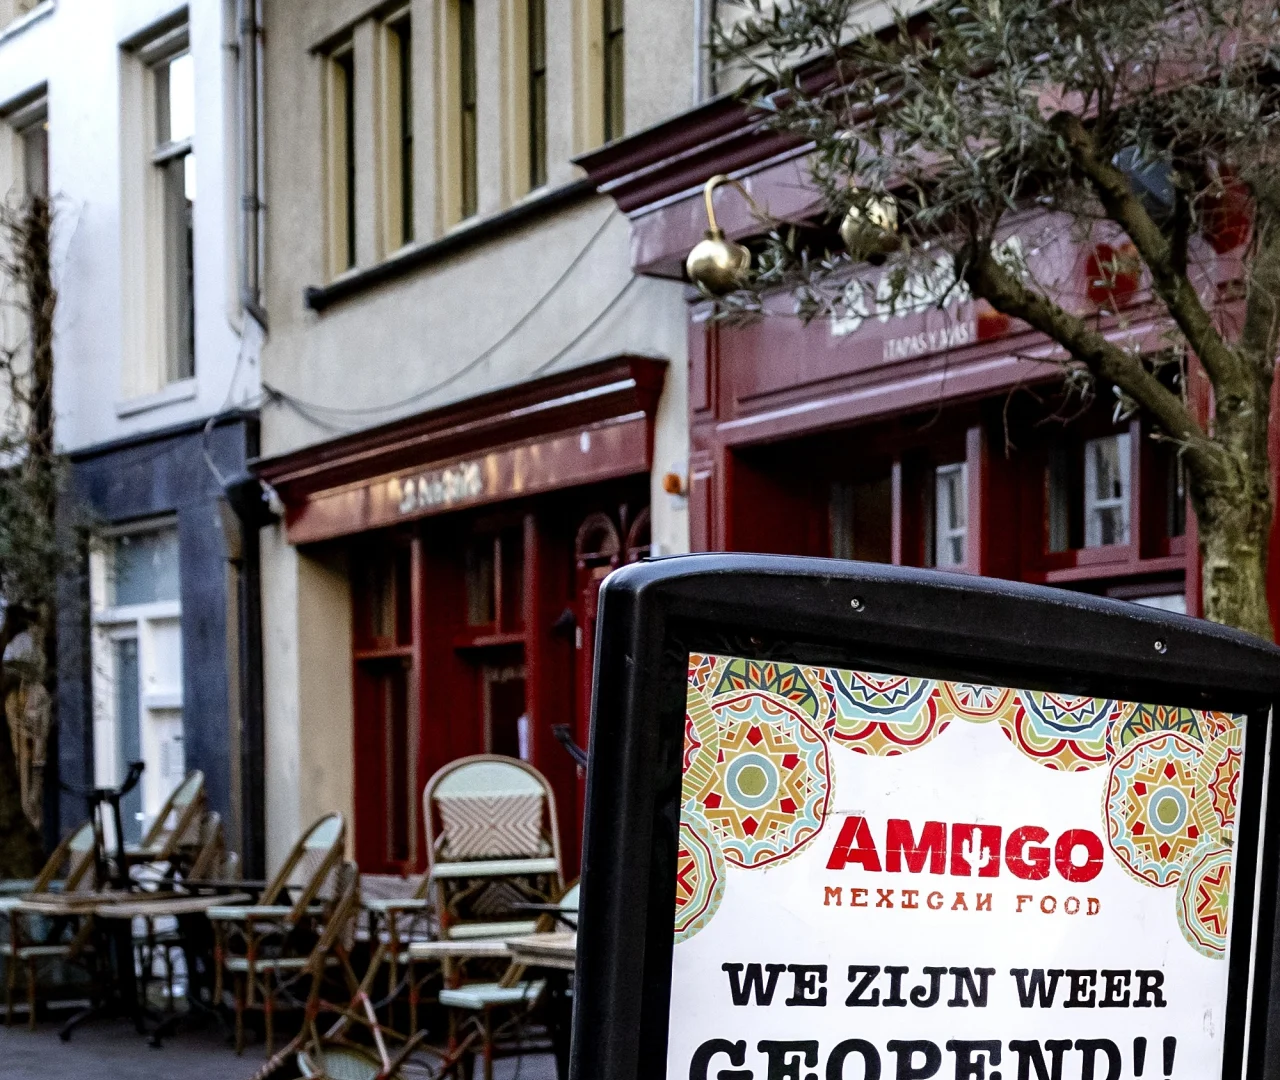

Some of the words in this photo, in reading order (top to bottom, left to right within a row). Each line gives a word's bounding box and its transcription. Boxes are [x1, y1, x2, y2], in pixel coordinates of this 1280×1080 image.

[1016, 895, 1100, 916] FOOD
[722, 963, 827, 1007] WE
[845, 965, 995, 1008] ZIJN
[1010, 969, 1167, 1008] WEER
